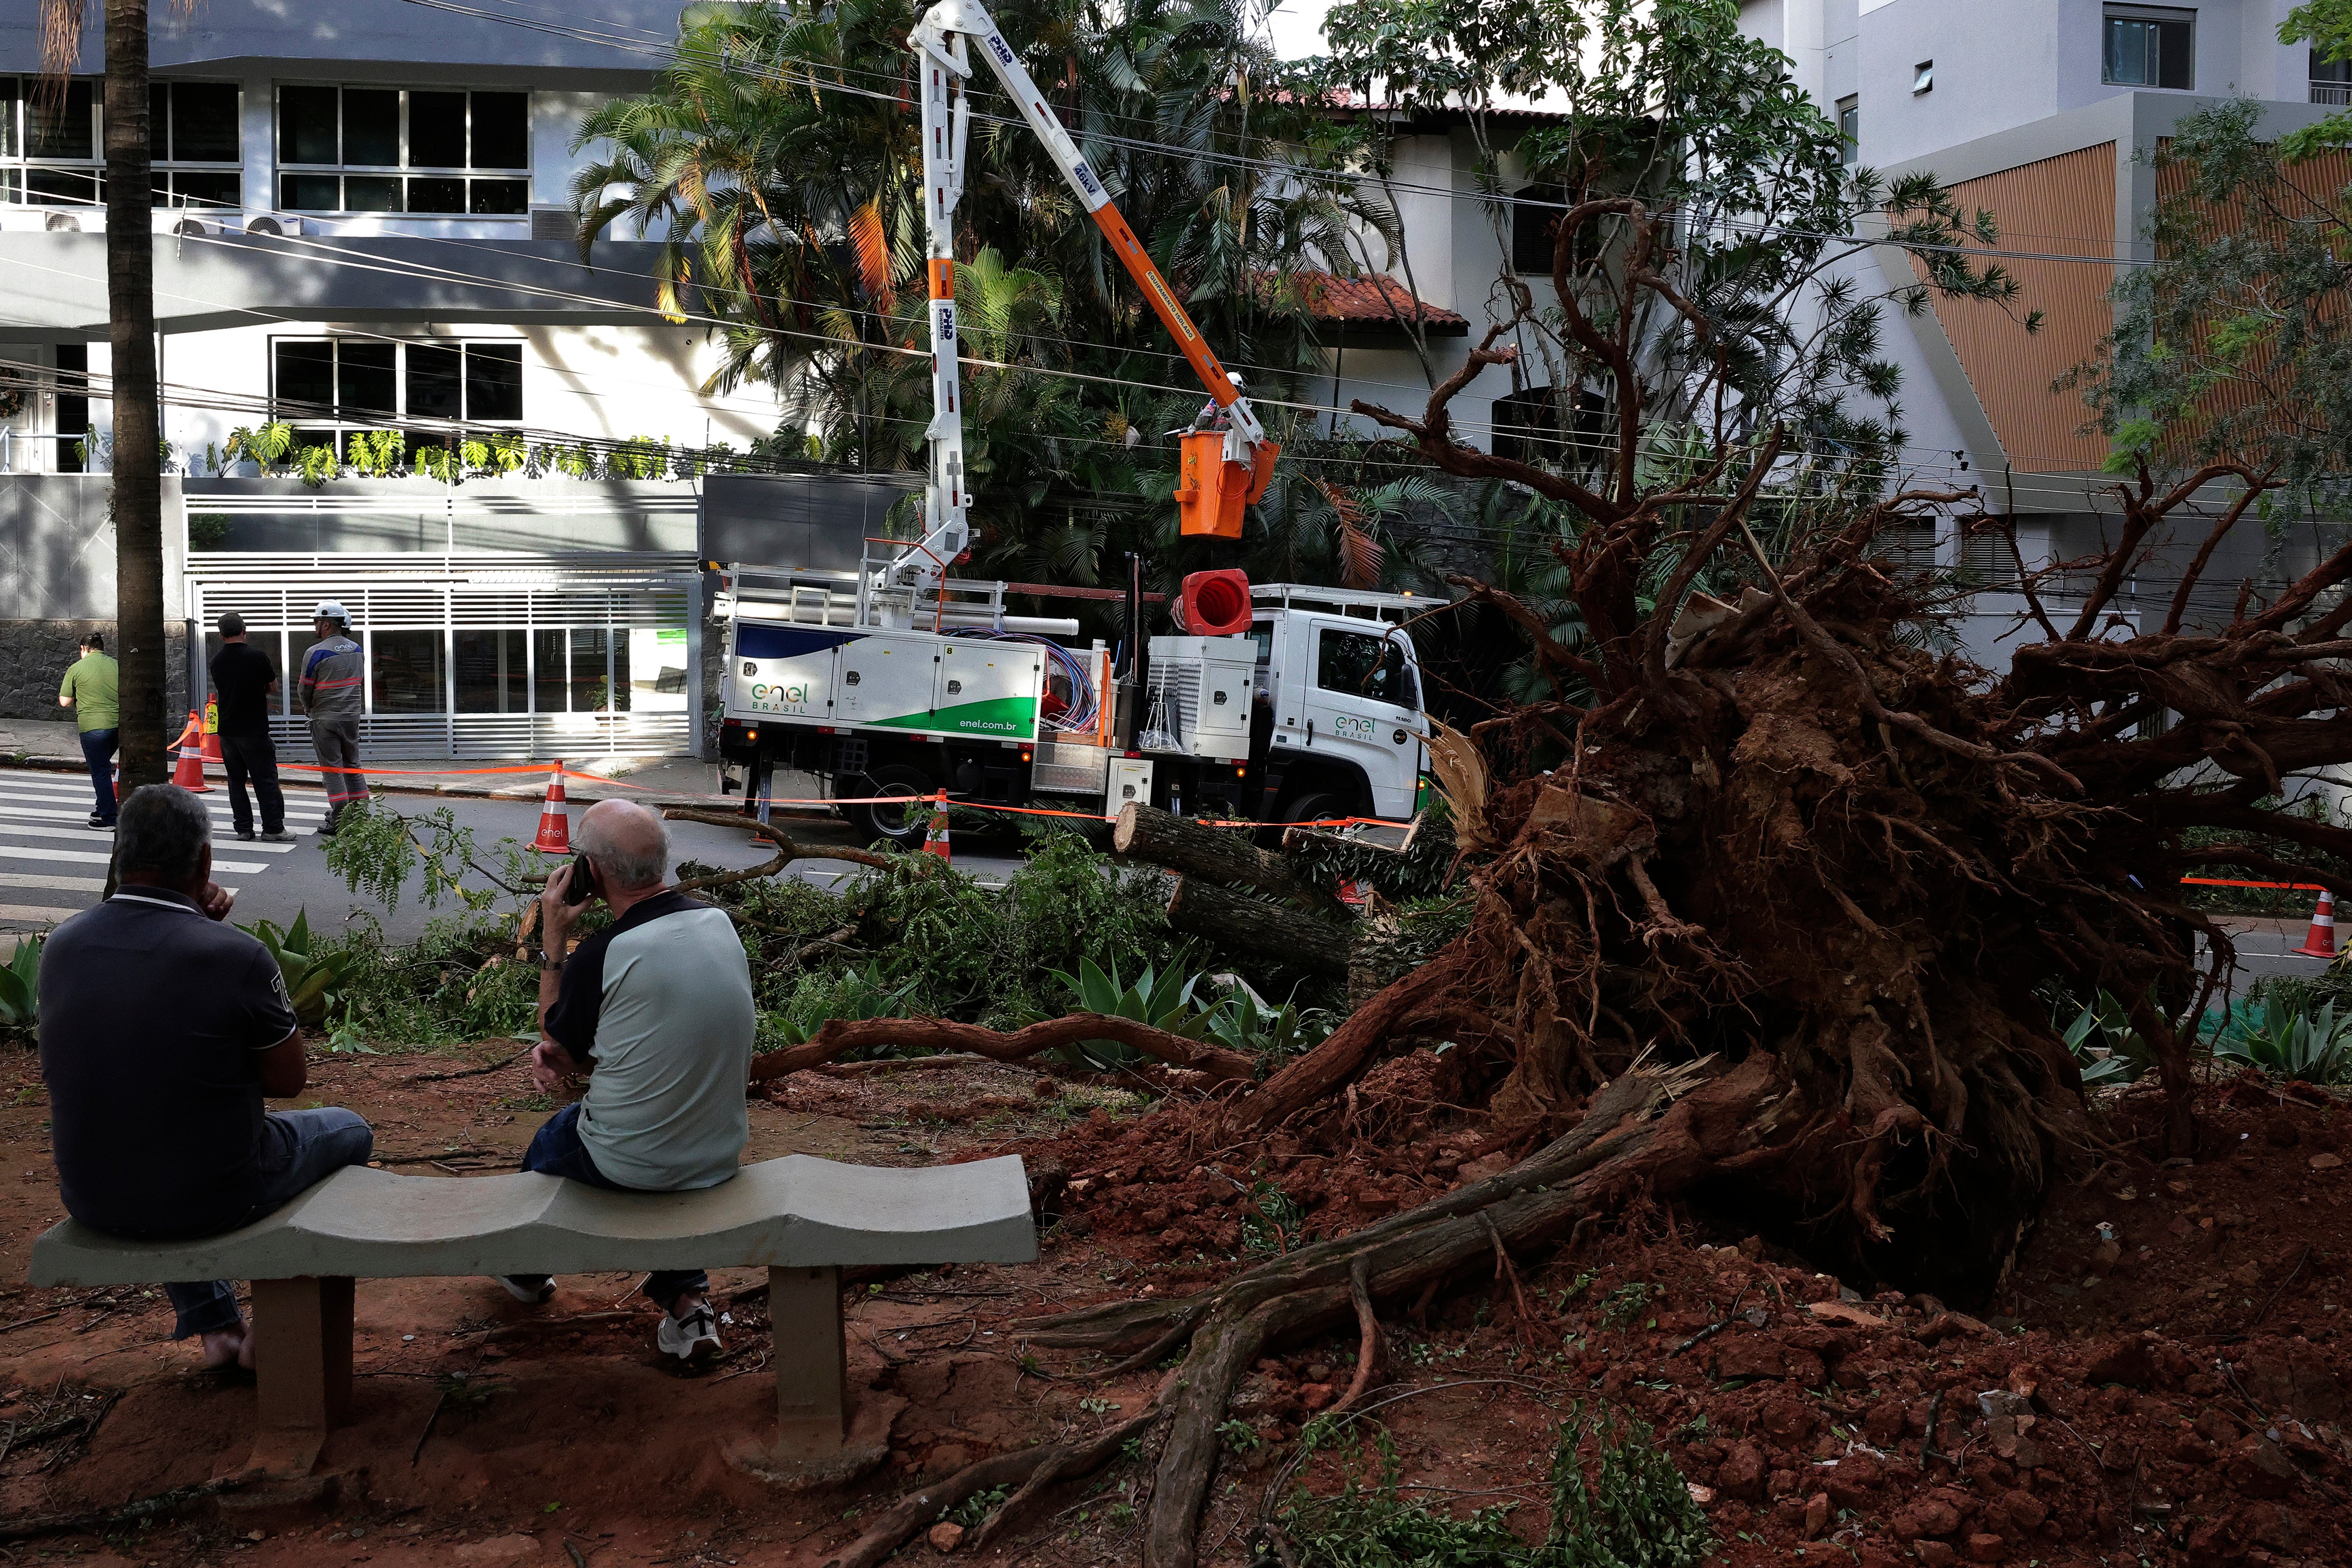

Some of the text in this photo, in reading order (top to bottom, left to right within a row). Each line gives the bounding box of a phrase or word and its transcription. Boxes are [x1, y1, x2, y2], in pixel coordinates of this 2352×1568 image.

[988, 40, 1008, 67] GUINDASTES
[990, 34, 1013, 64] PHD
[1074, 168, 1096, 193] 46kV
[1148, 271, 1193, 338] EQUIPAMENTO ISOLADO
[943, 308, 953, 340] PHD
[334, 642, 353, 652] enel
[752, 683, 808, 704] enel
[752, 701, 805, 714] BRASIL
[960, 720, 1016, 730] enel.com.br
[1336, 717, 1375, 733] enel
[1335, 730, 1372, 740] BRASIL
[541, 828, 563, 838] enel
